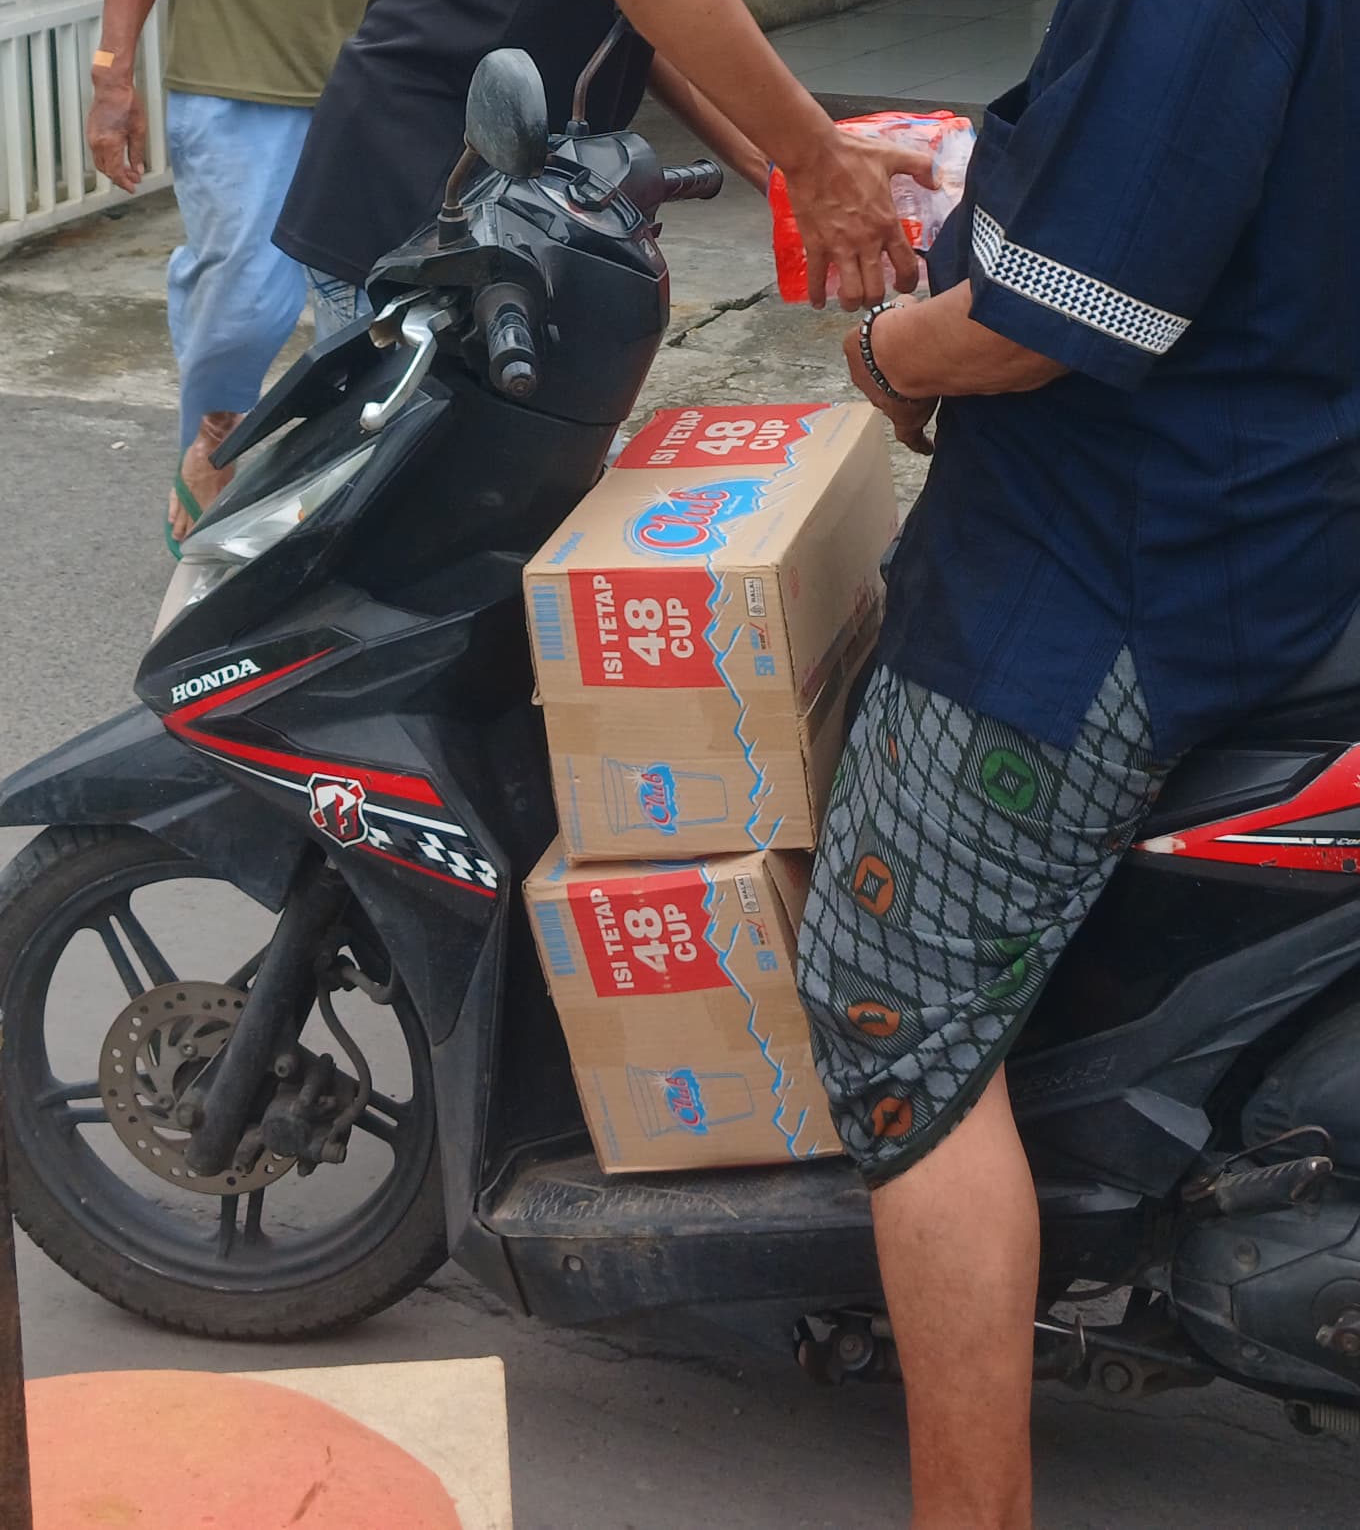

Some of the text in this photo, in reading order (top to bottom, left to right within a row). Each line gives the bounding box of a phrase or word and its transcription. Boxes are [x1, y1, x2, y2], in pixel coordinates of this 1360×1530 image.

[647, 410, 704, 465] ISI TETAP
[695, 419, 757, 455] 48
[748, 419, 790, 451] CUP
[640, 491, 730, 548] Club
[748, 579, 756, 603] HALAL
[593, 574, 624, 680] ISI TETAP
[623, 597, 666, 666] 48
[665, 597, 695, 658] CUP
[170, 658, 261, 704] HONDA
[641, 773, 671, 825] Club
[590, 888, 635, 989] ISI TETAP
[623, 906, 670, 973] 48
[663, 903, 698, 962] CUP
[665, 1077, 700, 1126] Club
